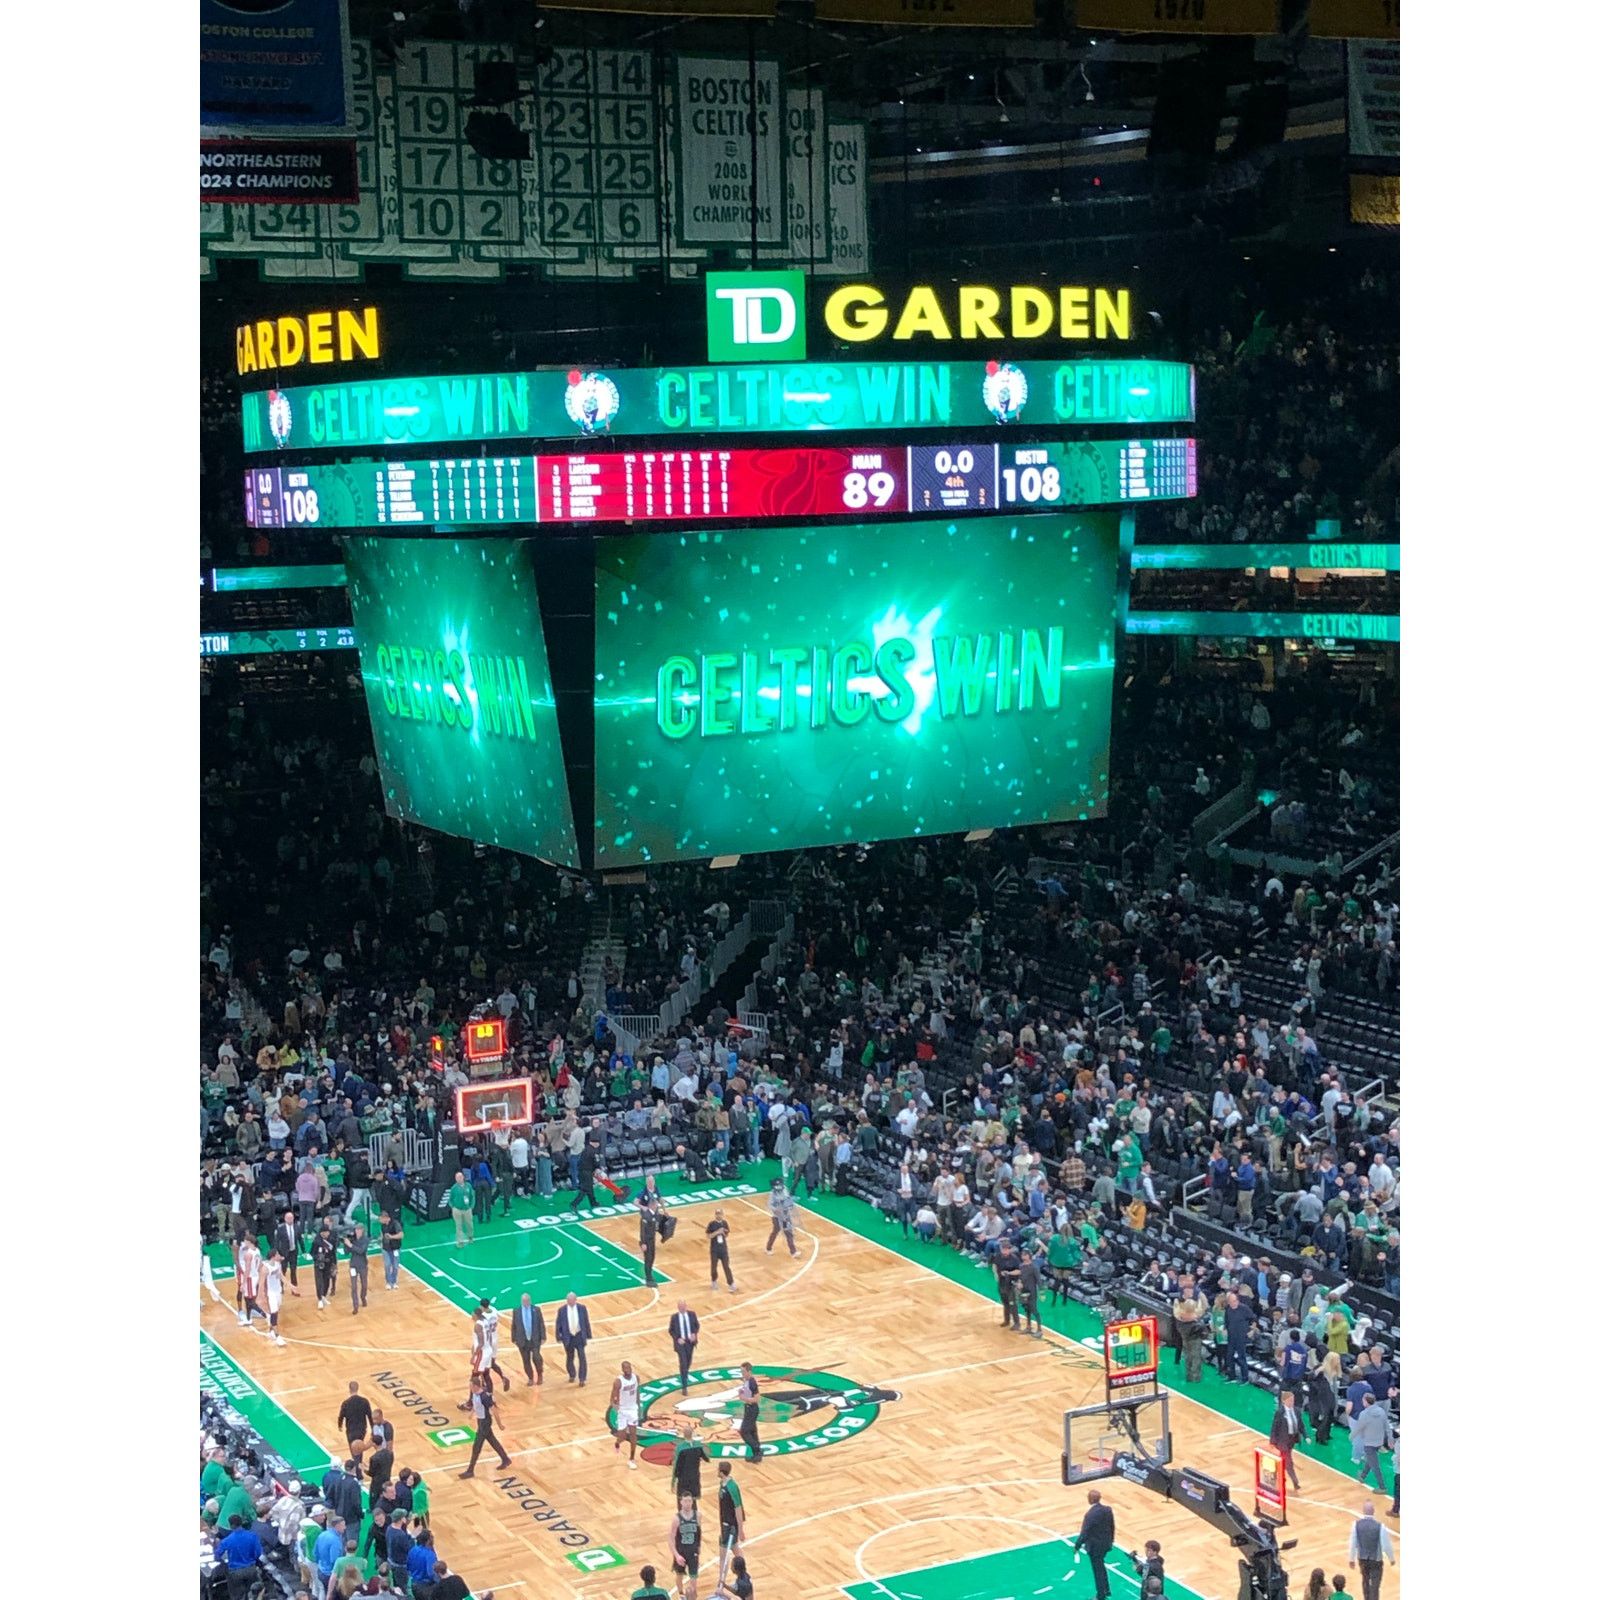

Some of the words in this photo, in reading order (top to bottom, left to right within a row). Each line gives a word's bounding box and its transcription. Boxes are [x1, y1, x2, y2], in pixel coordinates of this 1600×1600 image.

[253, 27, 315, 38] COLLEGE
[412, 47, 428, 84] 1
[543, 52, 590, 89] 22
[606, 54, 644, 91] 14
[688, 77, 772, 105] BOSTON
[405, 96, 449, 134] 19
[544, 101, 590, 139] 23
[606, 102, 647, 140] 15
[200, 153, 322, 168] NORTHEASTERN
[406, 147, 451, 186] 17
[468, 153, 512, 187] 18
[550, 152, 591, 190] 21
[604, 152, 652, 190] 25
[714, 162, 748, 180] 2008
[236, 174, 333, 188] CHAMPIONS
[259, 204, 311, 232] 34
[338, 204, 360, 233] 5
[409, 198, 454, 236] 10
[480, 200, 502, 236] 2
[548, 202, 593, 238] 24
[618, 202, 641, 239] 6
[692, 206, 772, 224] CHAMPIONS
[716, 288, 797, 344] TD
[823, 284, 1130, 342] GARDEN
[308, 381, 431, 444] CELTICS
[438, 374, 529, 436] WIN
[658, 366, 846, 429] CELTICS
[856, 364, 951, 423] WIN
[1054, 366, 1157, 422] CELTICS
[1156, 364, 1189, 418] WIN
[852, 454, 882, 469] MIAMI
[934, 450, 974, 474] 0.0
[842, 472, 896, 508] 89
[944, 476, 965, 488] 4th
[1003, 466, 1060, 502] 108
[283, 489, 320, 523] 108
[1308, 544, 1359, 568] CELTICS
[1359, 546, 1388, 568] WIN
[299, 639, 306, 648] 5
[320, 638, 326, 646] 2
[1303, 613, 1360, 638] CELTICS
[1360, 616, 1388, 639] WIN
[377, 643, 472, 730] CELTICS
[470, 654, 537, 743] WIN
[657, 637, 917, 740] CELTICS
[931, 626, 1065, 719] WIN
[513, 1202, 641, 1229] BOSTON
[663, 1183, 758, 1207] ELTICS
[640, 1368, 744, 1403] ELTICS
[1124, 1371, 1155, 1384] TISSOT
[370, 1370, 450, 1427] GARDEN
[721, 1416, 866, 1457] BOSTON
[493, 1476, 590, 1547] GARDEN
